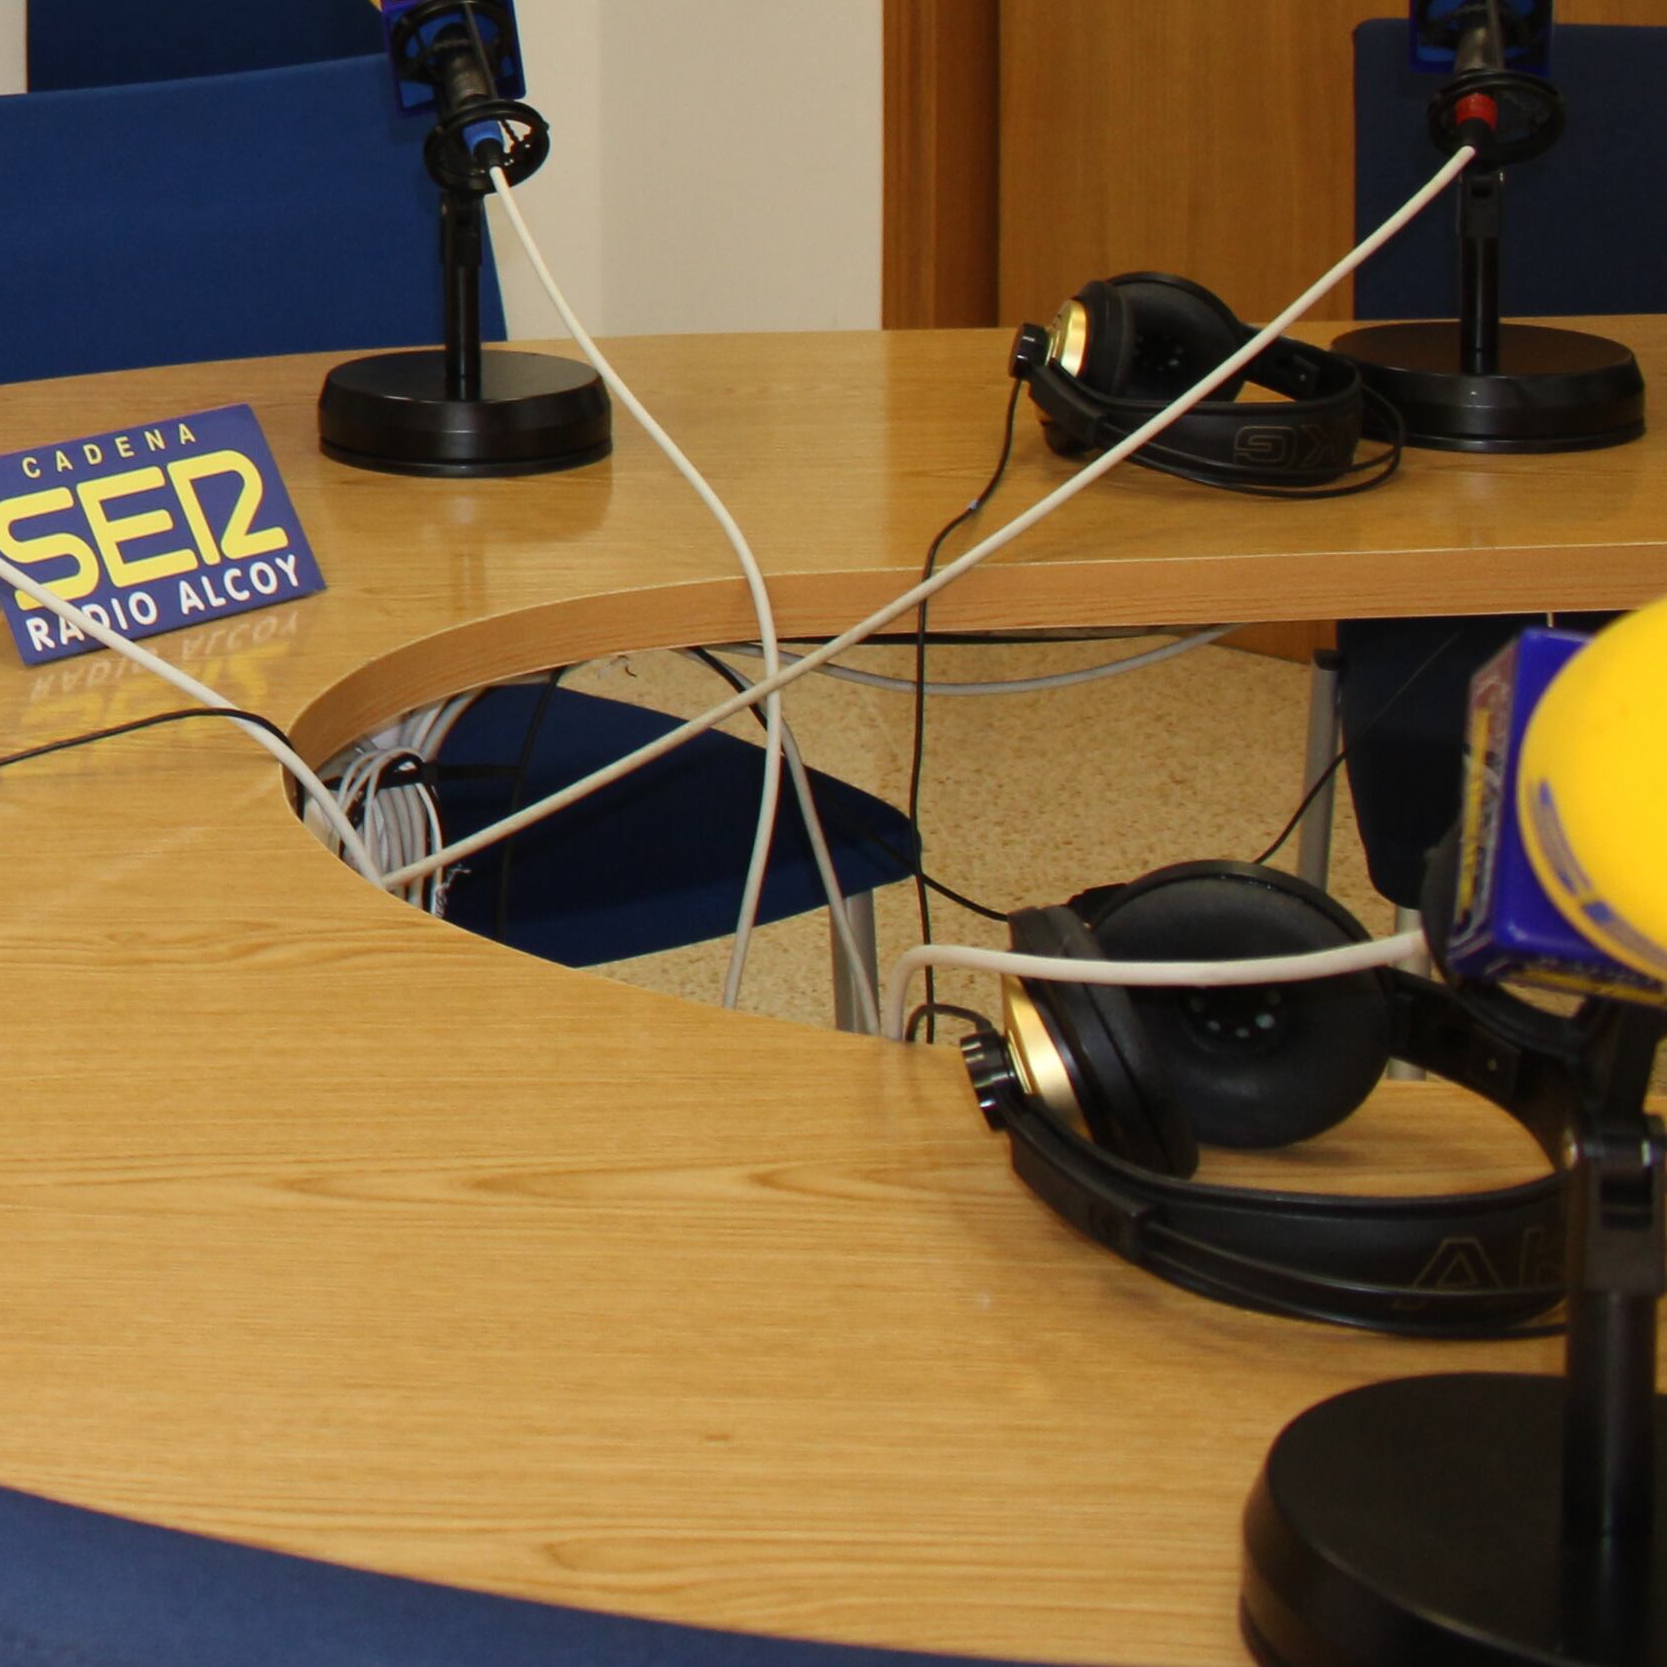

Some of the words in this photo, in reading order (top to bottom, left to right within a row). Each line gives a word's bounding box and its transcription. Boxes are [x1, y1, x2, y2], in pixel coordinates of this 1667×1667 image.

[22, 423, 197, 480] CADENA
[25, 591, 159, 653] RADIO
[178, 554, 301, 616] ALCOY
